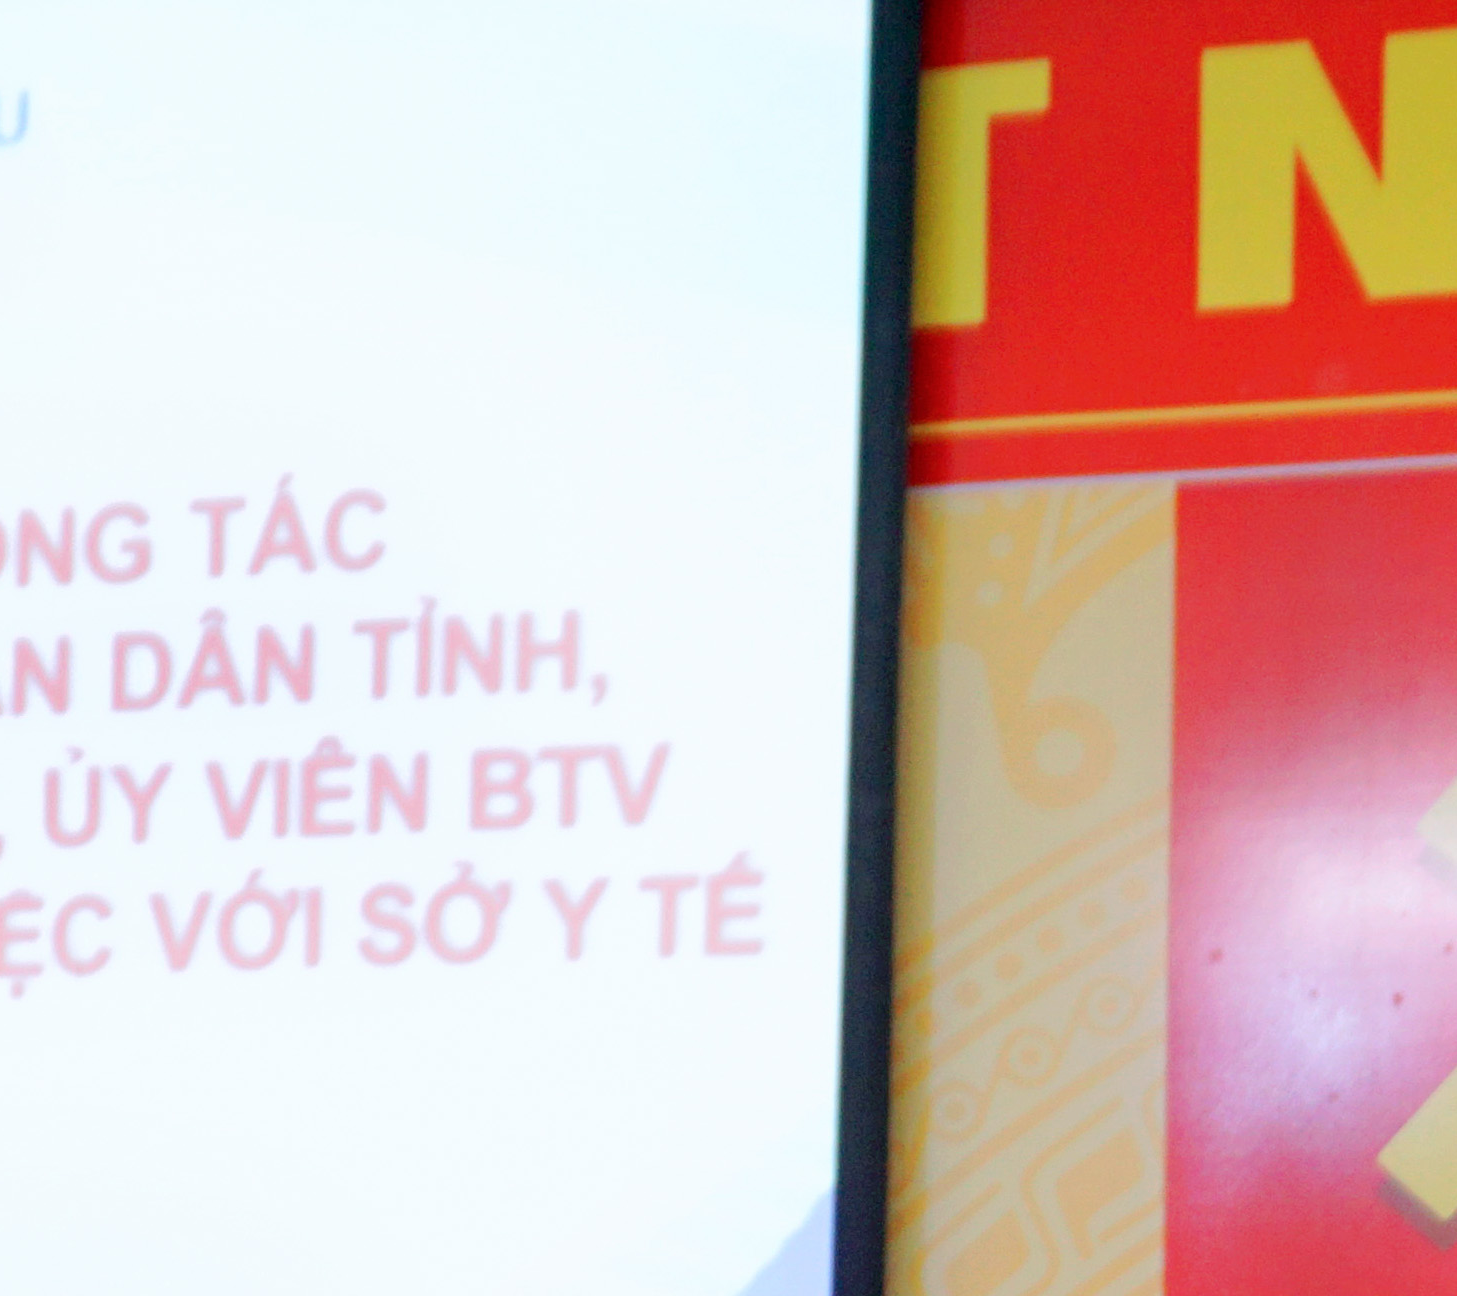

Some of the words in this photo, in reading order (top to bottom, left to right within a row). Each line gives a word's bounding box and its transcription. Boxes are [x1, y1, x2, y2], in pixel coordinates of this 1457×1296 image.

[190, 474, 386, 577] TÁC
[111, 610, 316, 712] DÂN
[43, 748, 172, 848] ỦY
[206, 738, 429, 840] VIÊN
[469, 743, 670, 830] BTV
[149, 870, 323, 972] VỚI
[358, 863, 513, 967] SỞ
[543, 877, 608, 961] Y
